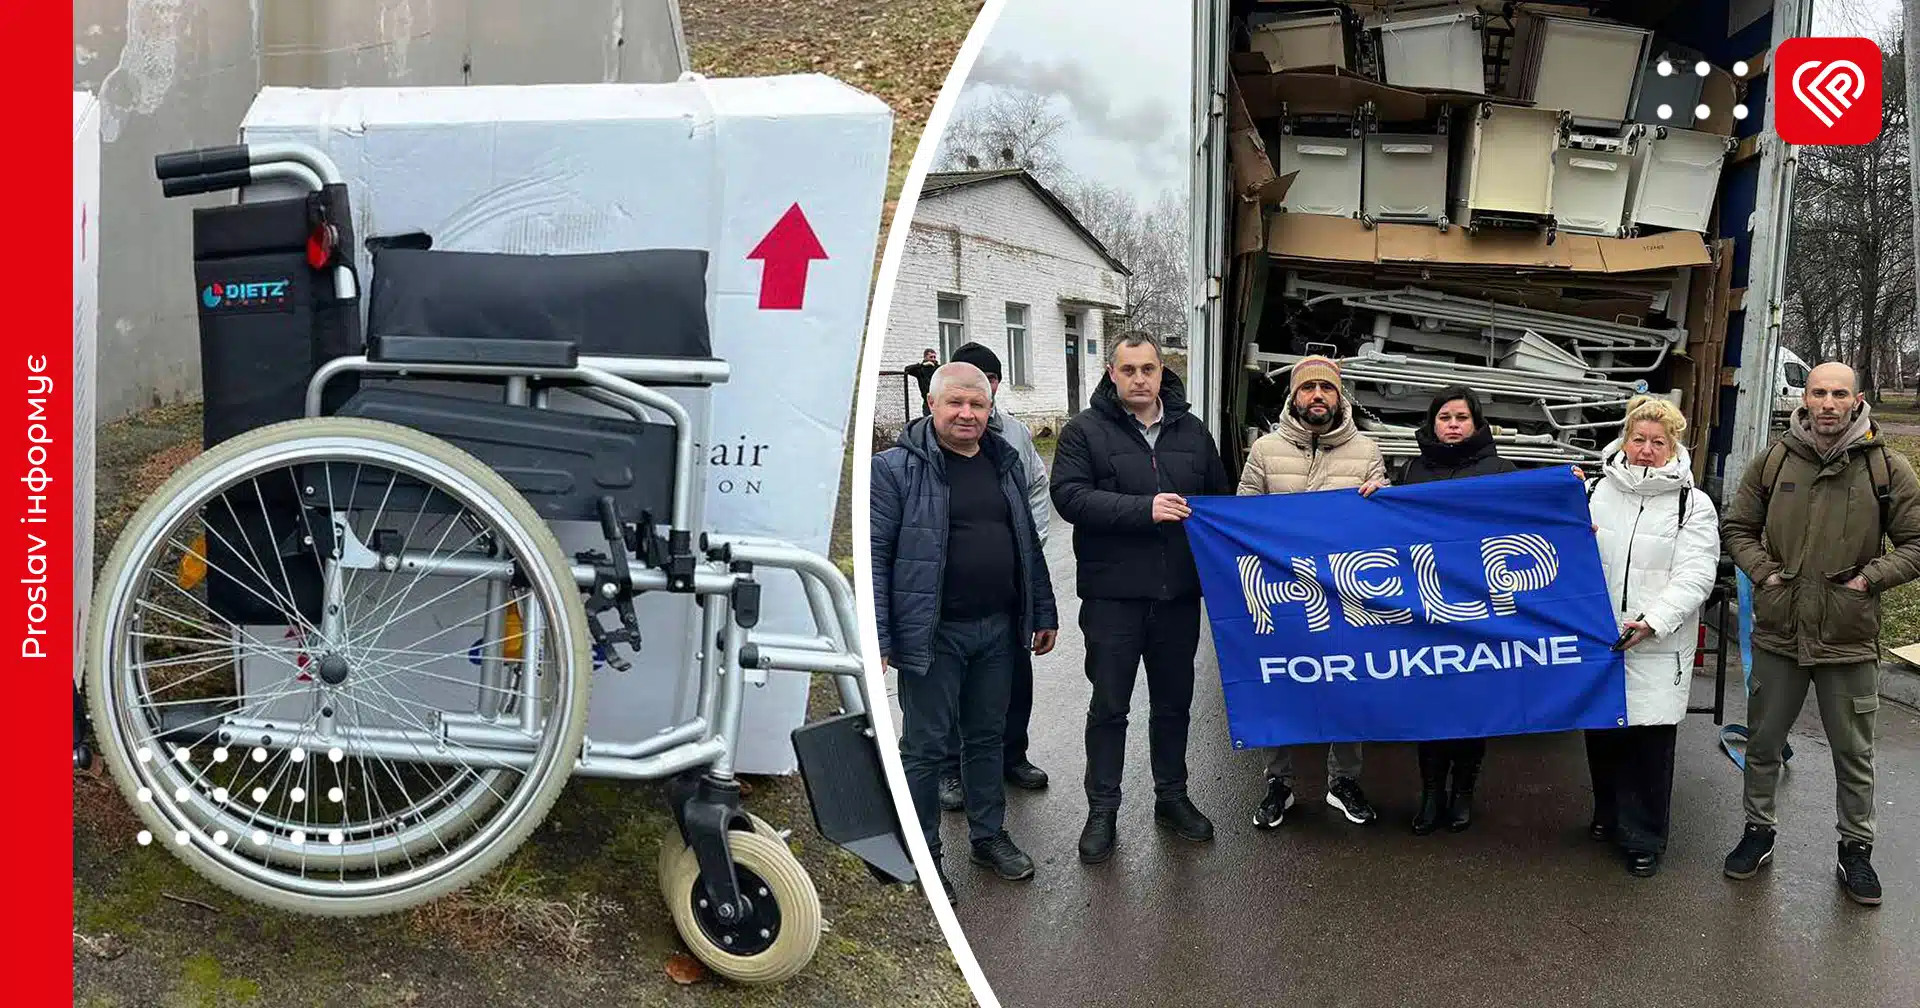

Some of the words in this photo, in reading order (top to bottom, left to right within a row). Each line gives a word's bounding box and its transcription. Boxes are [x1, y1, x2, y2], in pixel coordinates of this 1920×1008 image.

[225, 281, 285, 299] DIETZ
[1235, 533, 1560, 636] HELP
[1259, 655, 1358, 684] FOR
[1364, 635, 1582, 680] UKRAINE
